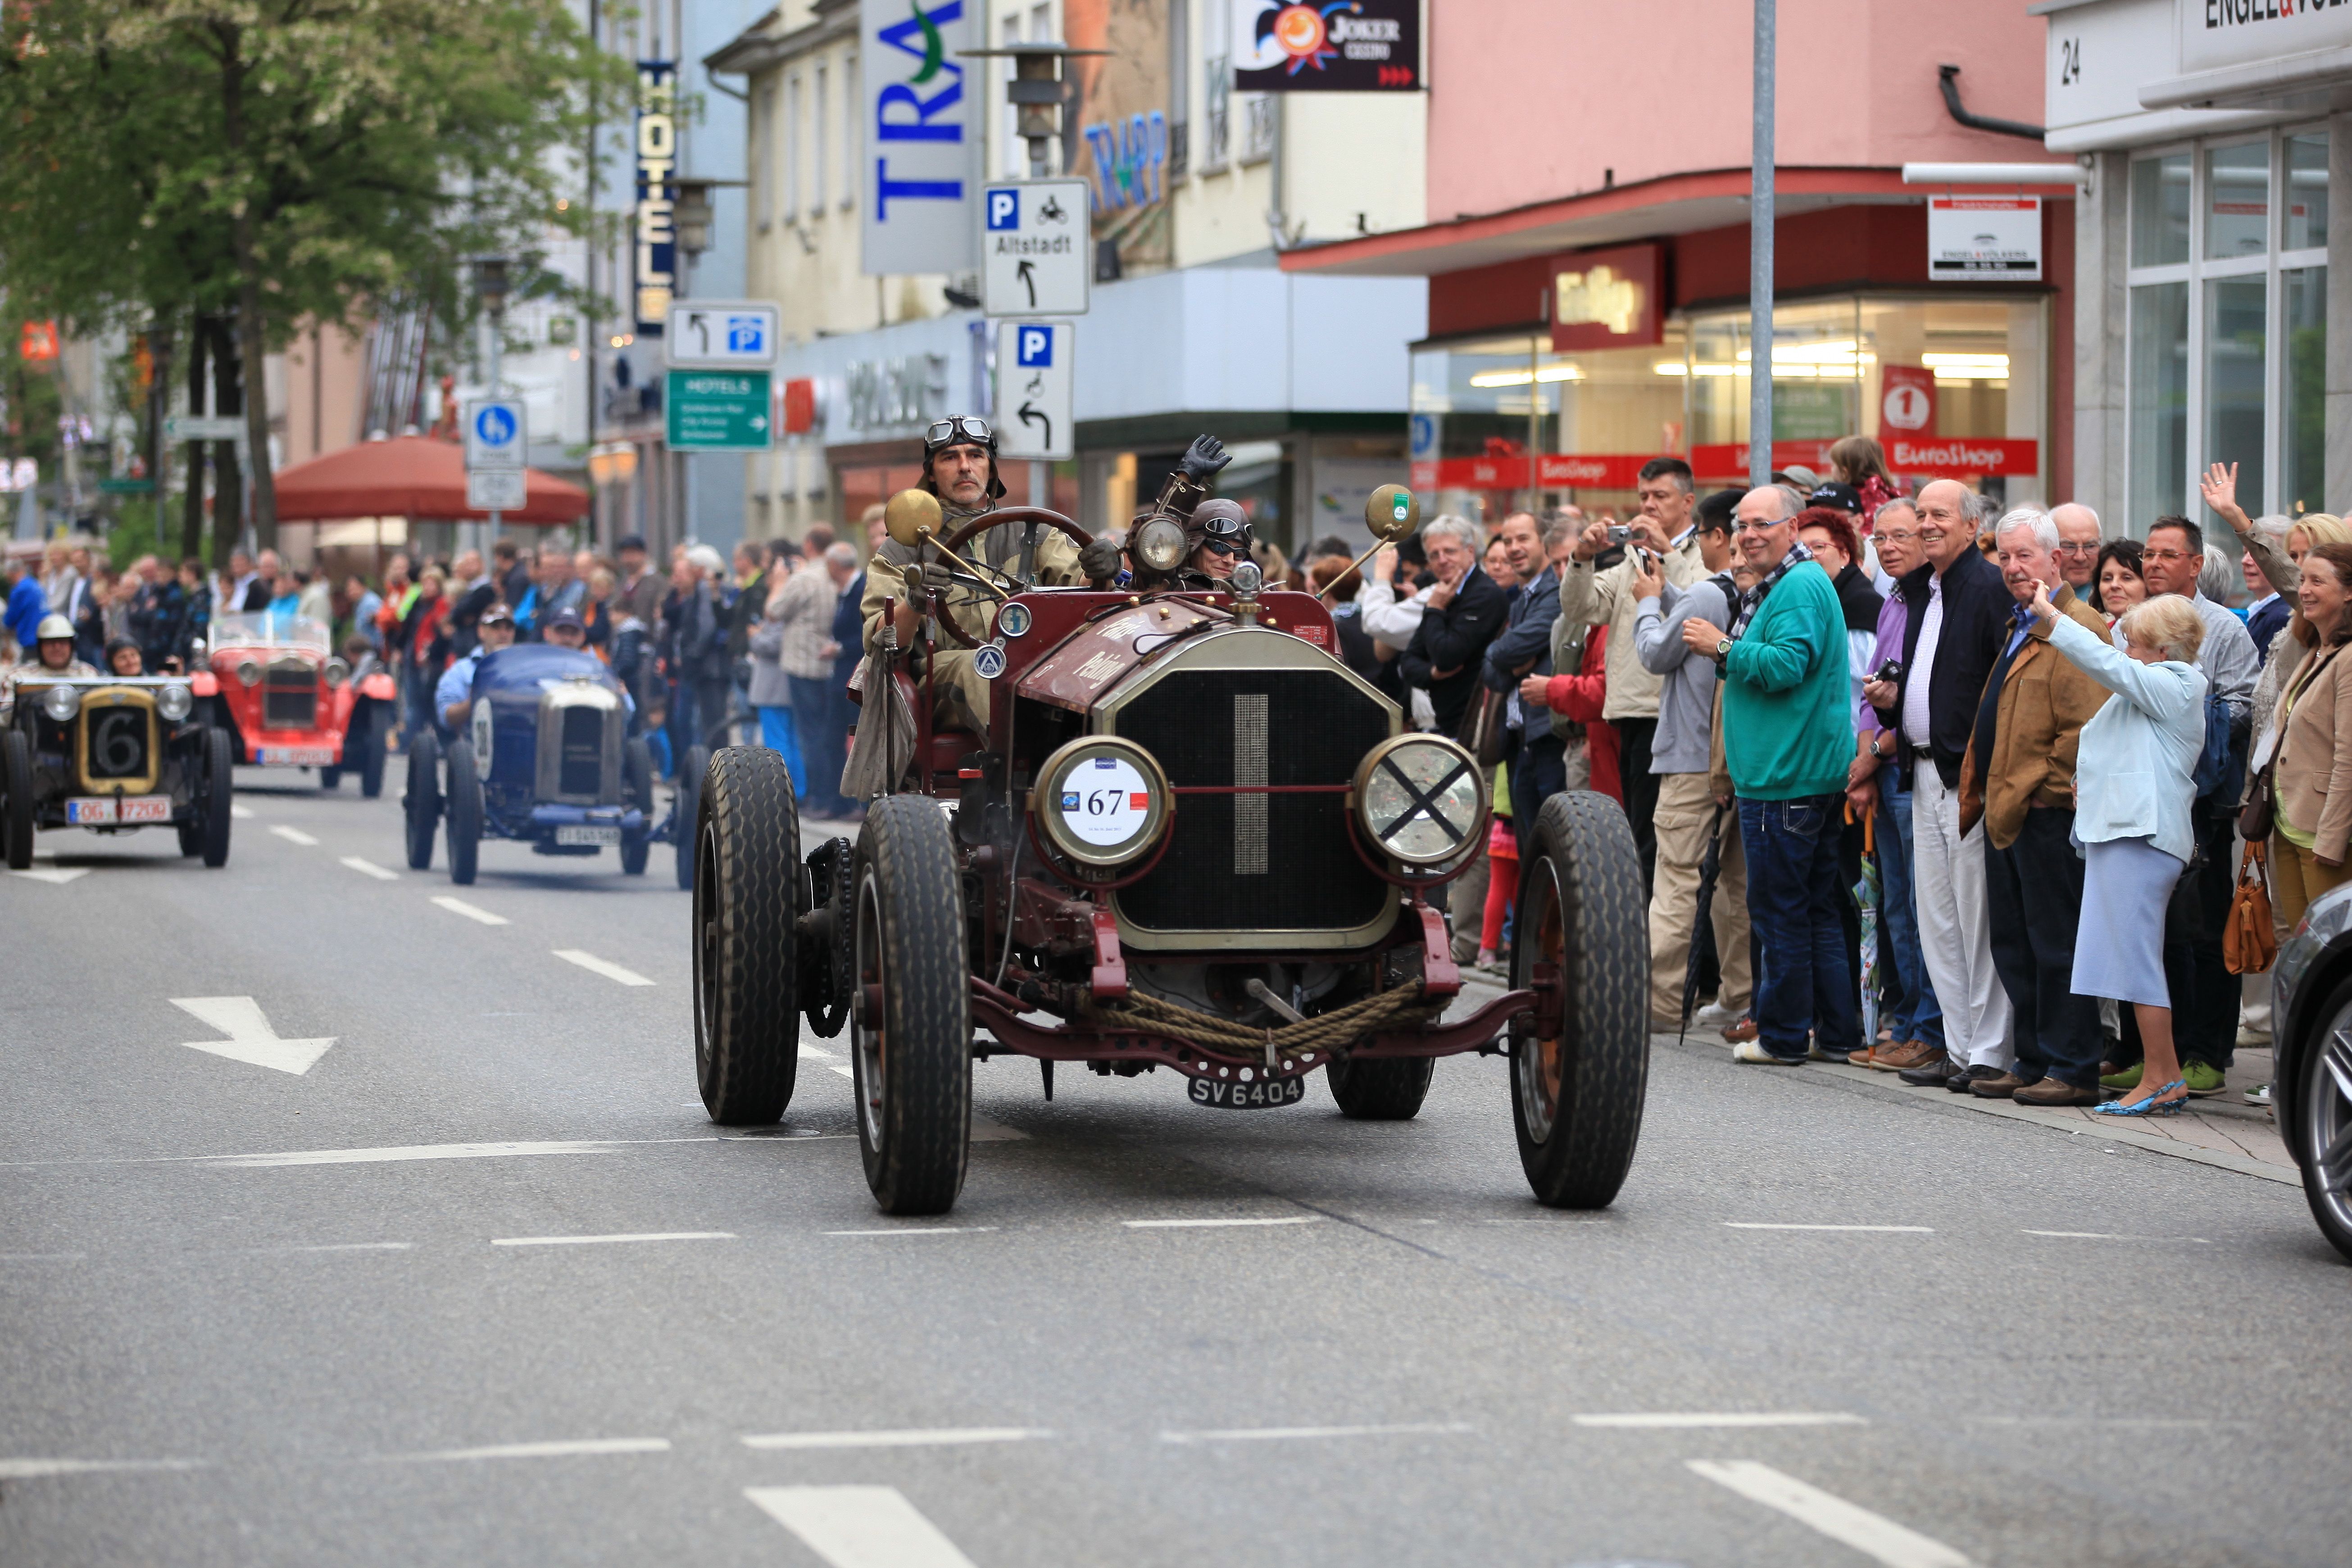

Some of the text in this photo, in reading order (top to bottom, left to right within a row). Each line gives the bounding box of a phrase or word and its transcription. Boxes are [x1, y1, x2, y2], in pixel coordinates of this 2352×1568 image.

[2061, 37, 2081, 86] 24
[638, 70, 674, 286] HOTEL
[991, 194, 1015, 227] P
[995, 235, 1071, 254] Altstadt
[1023, 331, 1047, 362] P
[684, 376, 752, 395] HOTELS
[1899, 389, 1913, 416] 1
[1893, 441, 2005, 471] EuroShop
[95, 711, 141, 775] 6
[1088, 789, 1125, 816] 67
